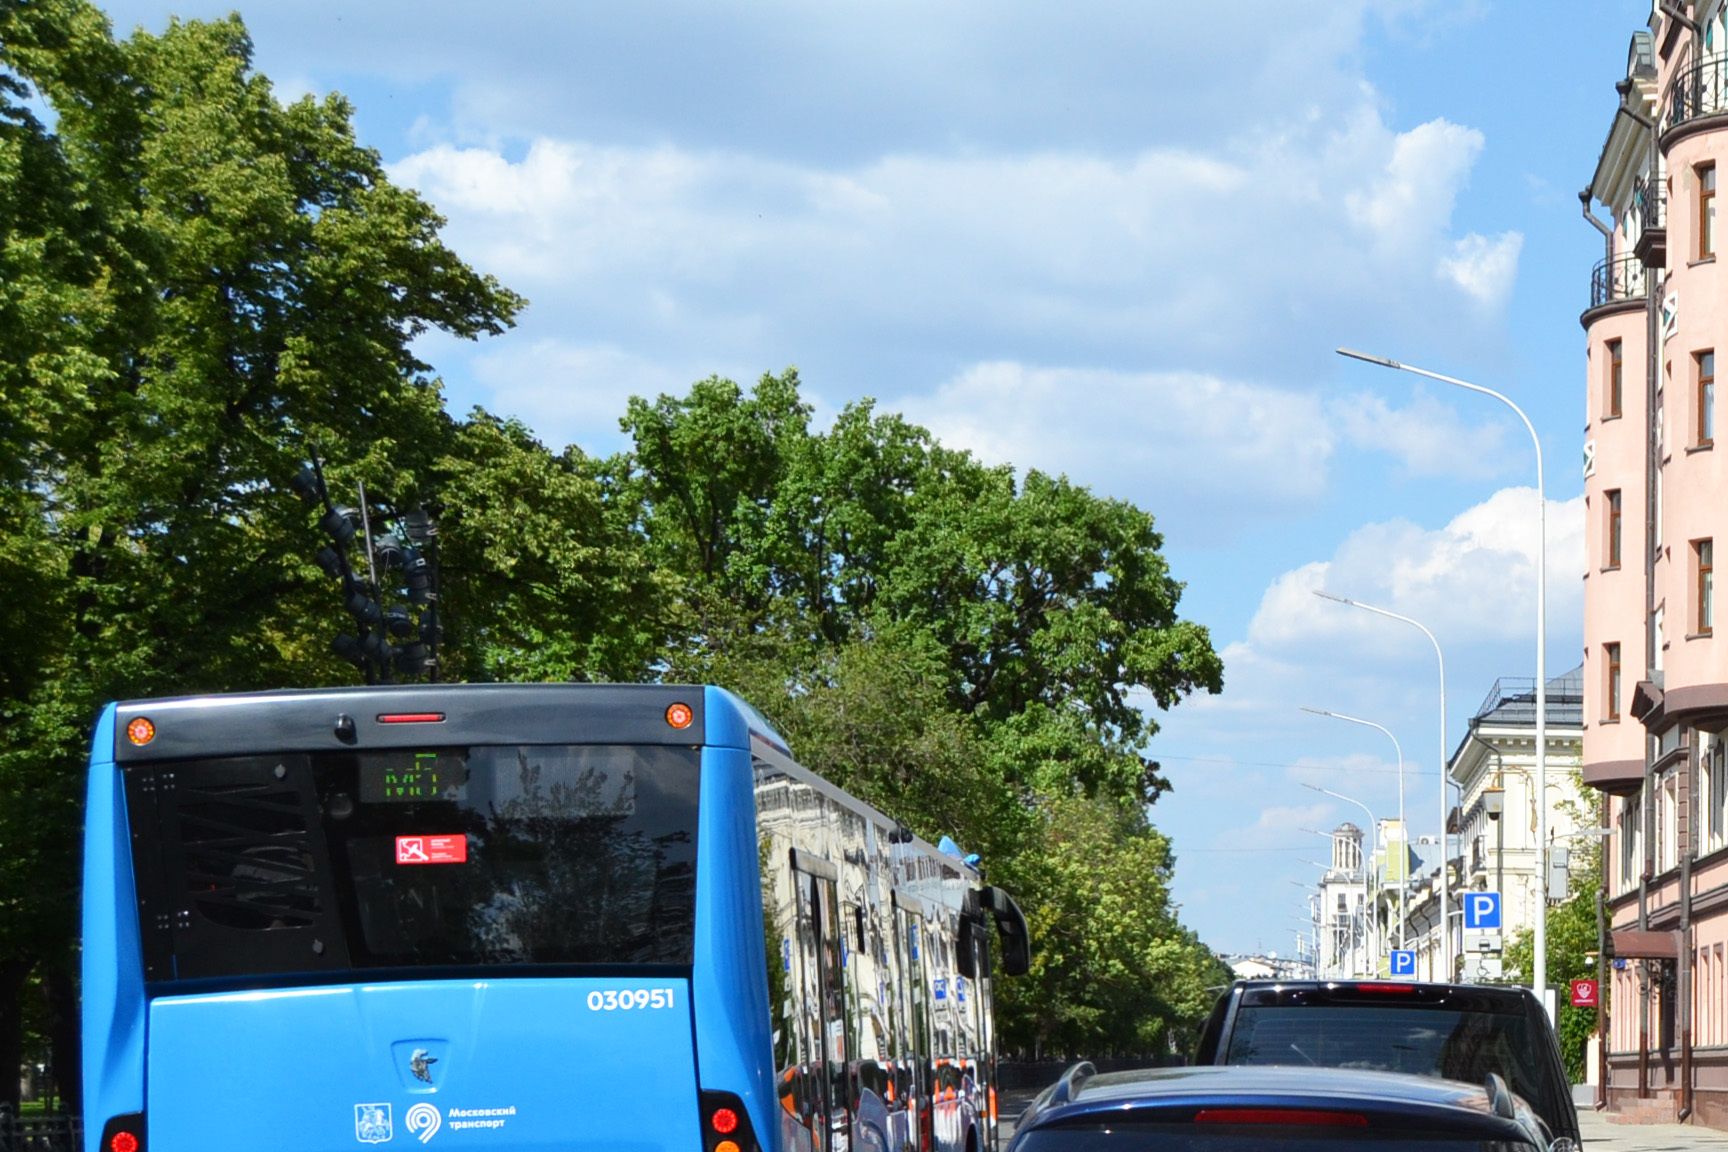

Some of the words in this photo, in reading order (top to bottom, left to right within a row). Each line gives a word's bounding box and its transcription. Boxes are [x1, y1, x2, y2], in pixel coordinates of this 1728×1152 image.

[1473, 896, 1494, 925] P
[1396, 953, 1411, 972] P
[587, 988, 674, 1011] 030951
[448, 1106, 516, 1118] Московский
[449, 1119, 505, 1131] транспорт
